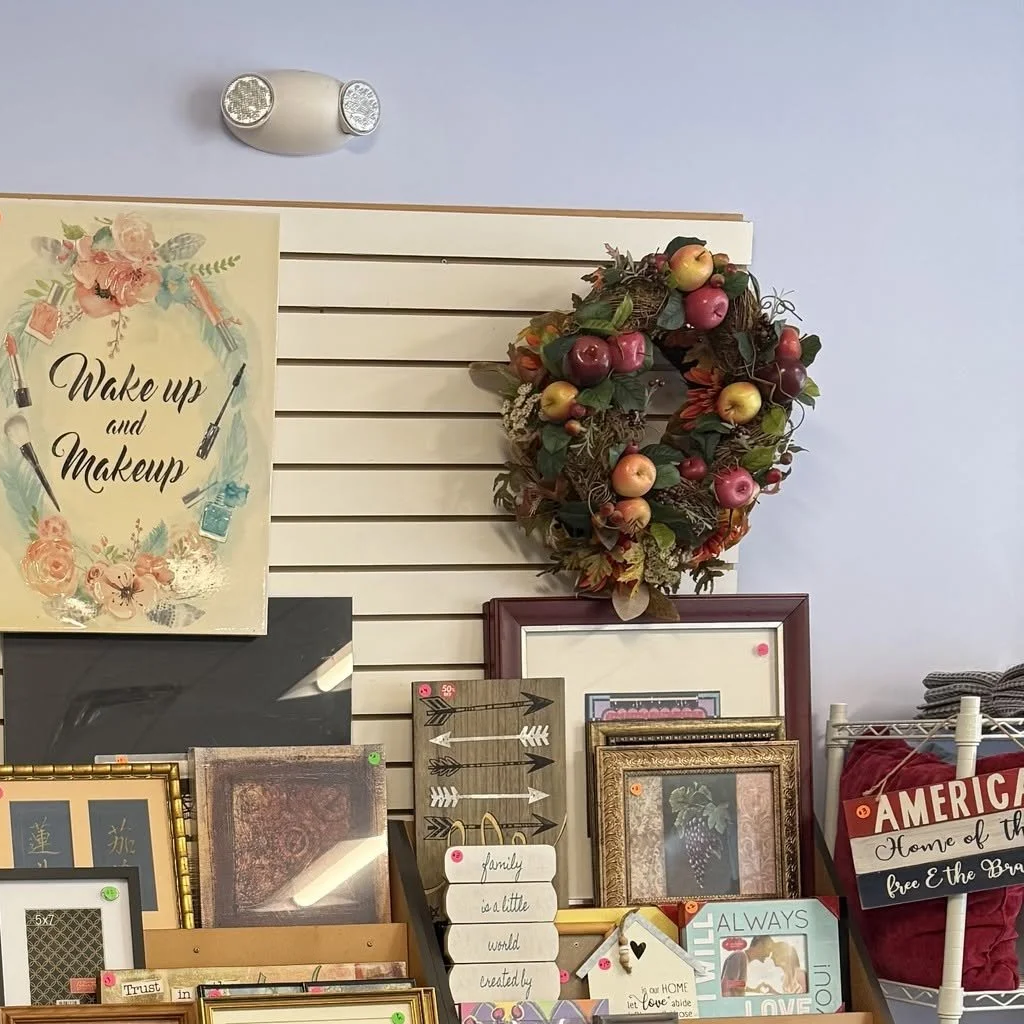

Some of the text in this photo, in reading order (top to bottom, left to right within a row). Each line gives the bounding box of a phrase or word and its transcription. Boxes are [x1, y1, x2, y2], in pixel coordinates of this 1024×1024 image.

[48, 351, 208, 414] Wake up
[106, 410, 148, 437] and
[51, 431, 190, 494] Makeup
[875, 834, 956, 861] Home
[963, 818, 990, 850] of
[481, 852, 524, 885] family
[886, 873, 920, 898] free
[942, 860, 976, 886] the
[481, 893, 530, 914] is a little
[34, 914, 55, 926] 5x7
[716, 909, 810, 932] ALWAYS
[487, 932, 521, 952] world
[692, 912, 716, 984] WILL
[123, 982, 191, 999] Trust in
[479, 967, 534, 1000] created by
[661, 982, 689, 994] HOME
[627, 992, 692, 1011] let love abide
